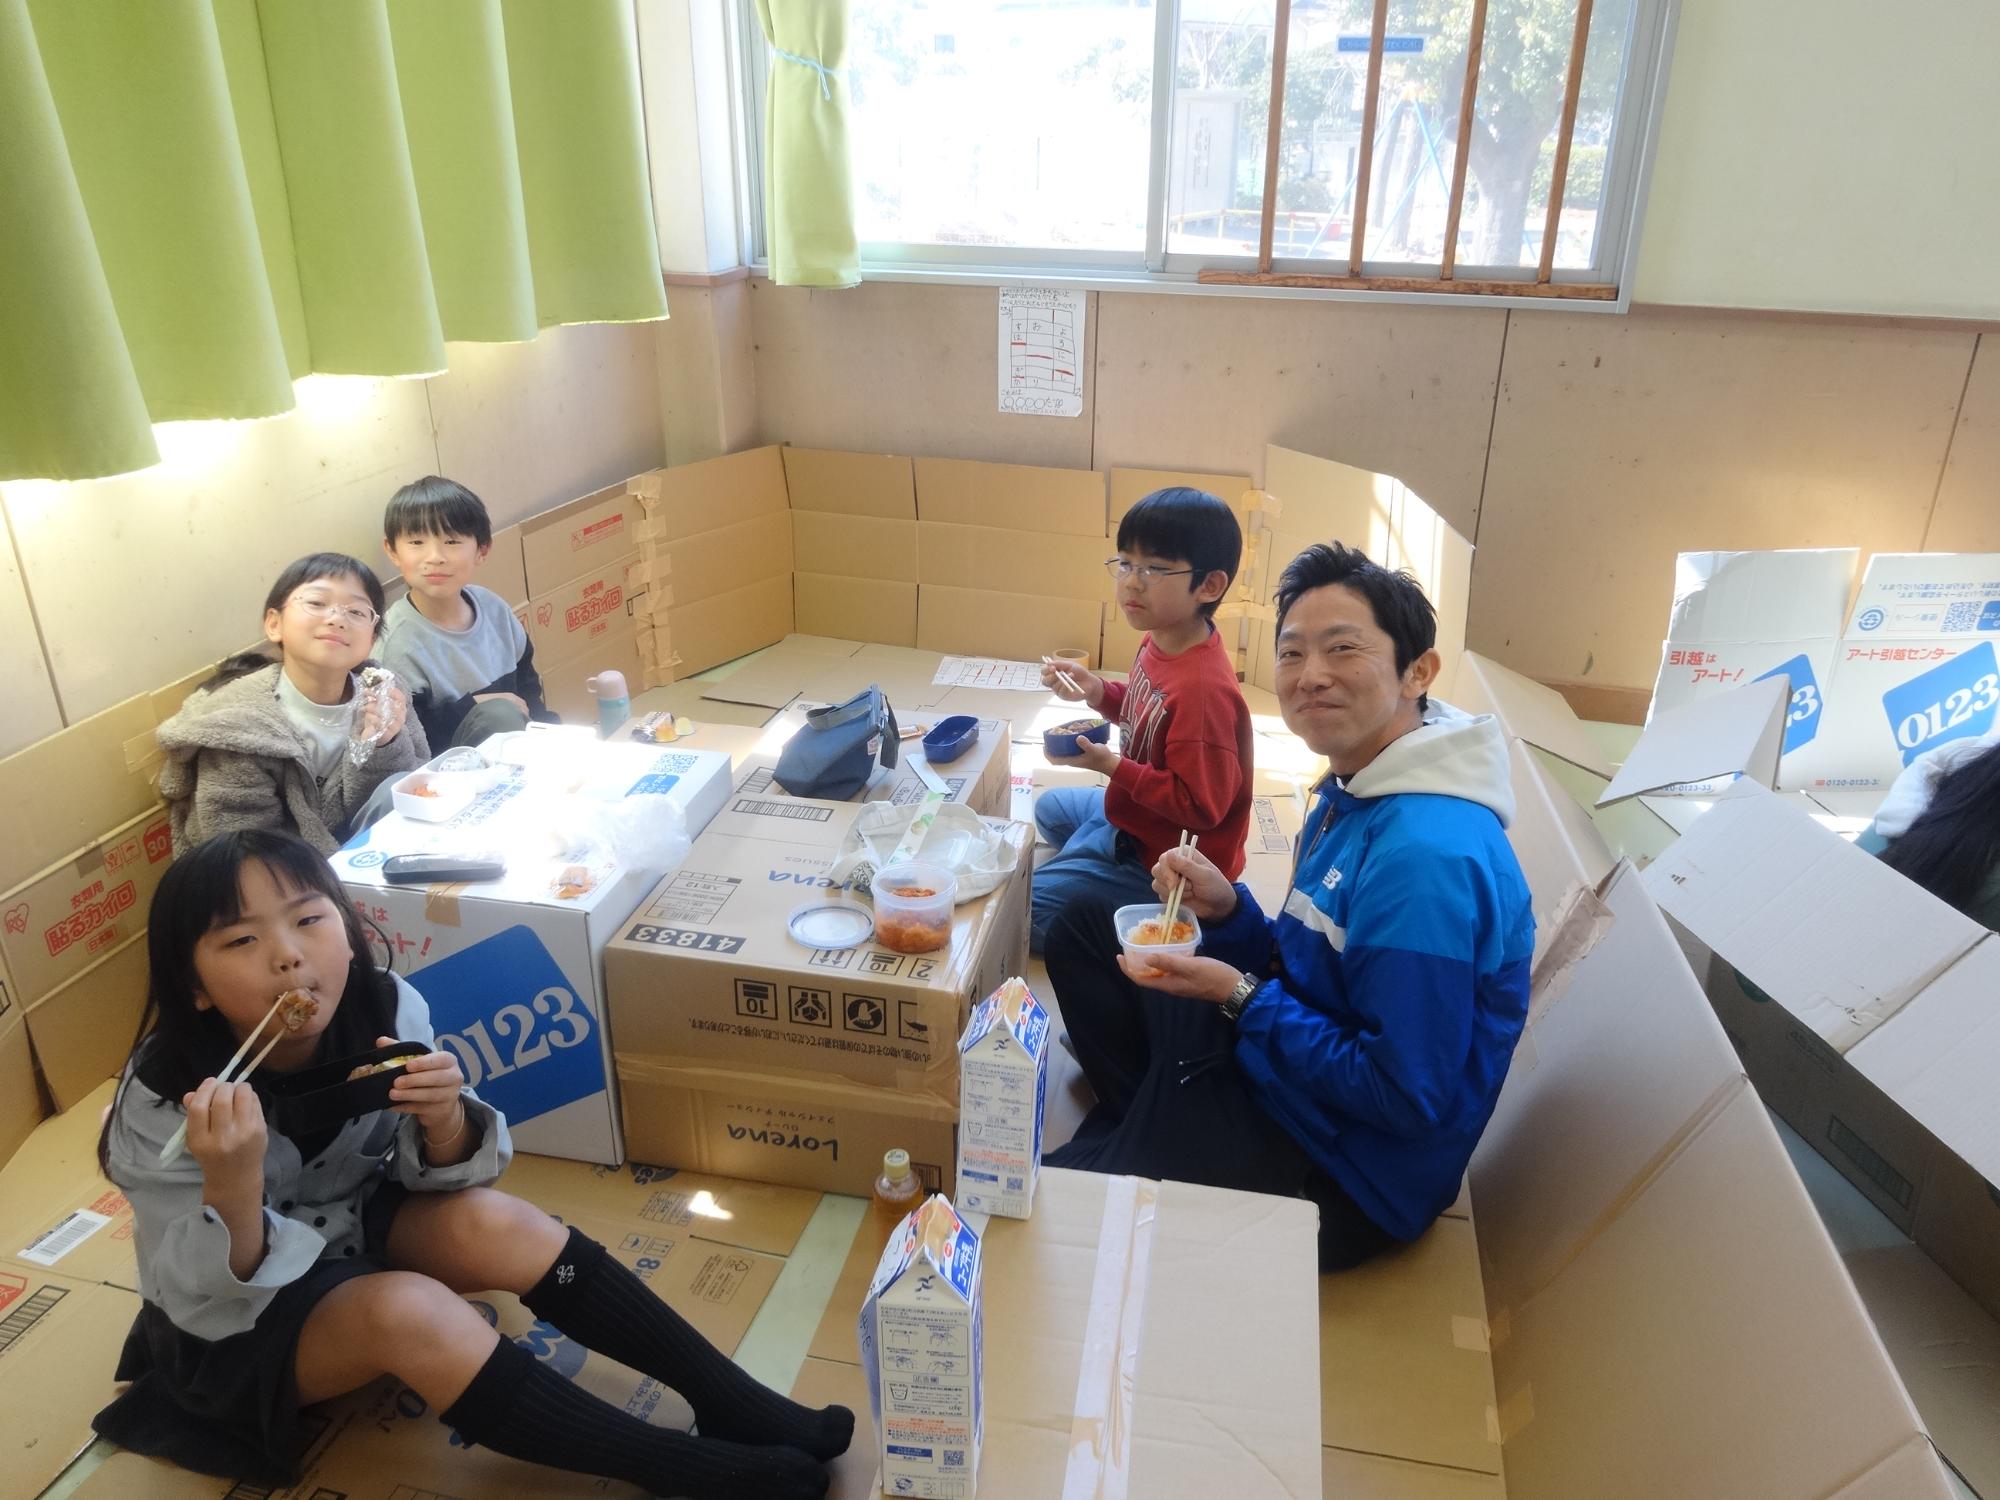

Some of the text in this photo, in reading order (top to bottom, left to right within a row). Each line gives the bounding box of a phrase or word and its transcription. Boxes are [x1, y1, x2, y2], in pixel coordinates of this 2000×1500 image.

[566, 586, 623, 632] 貼るカイロ
[1669, 650, 1717, 666] 引越は
[1846, 648, 1957, 661] アート引越センター
[1897, 673, 2000, 748] 0123
[46, 881, 135, 955] 貼るカイロ
[635, 926, 737, 951] 41833
[869, 962, 889, 973] 10
[746, 994, 769, 1014] 10
[726, 1122, 838, 1162] Lorena
